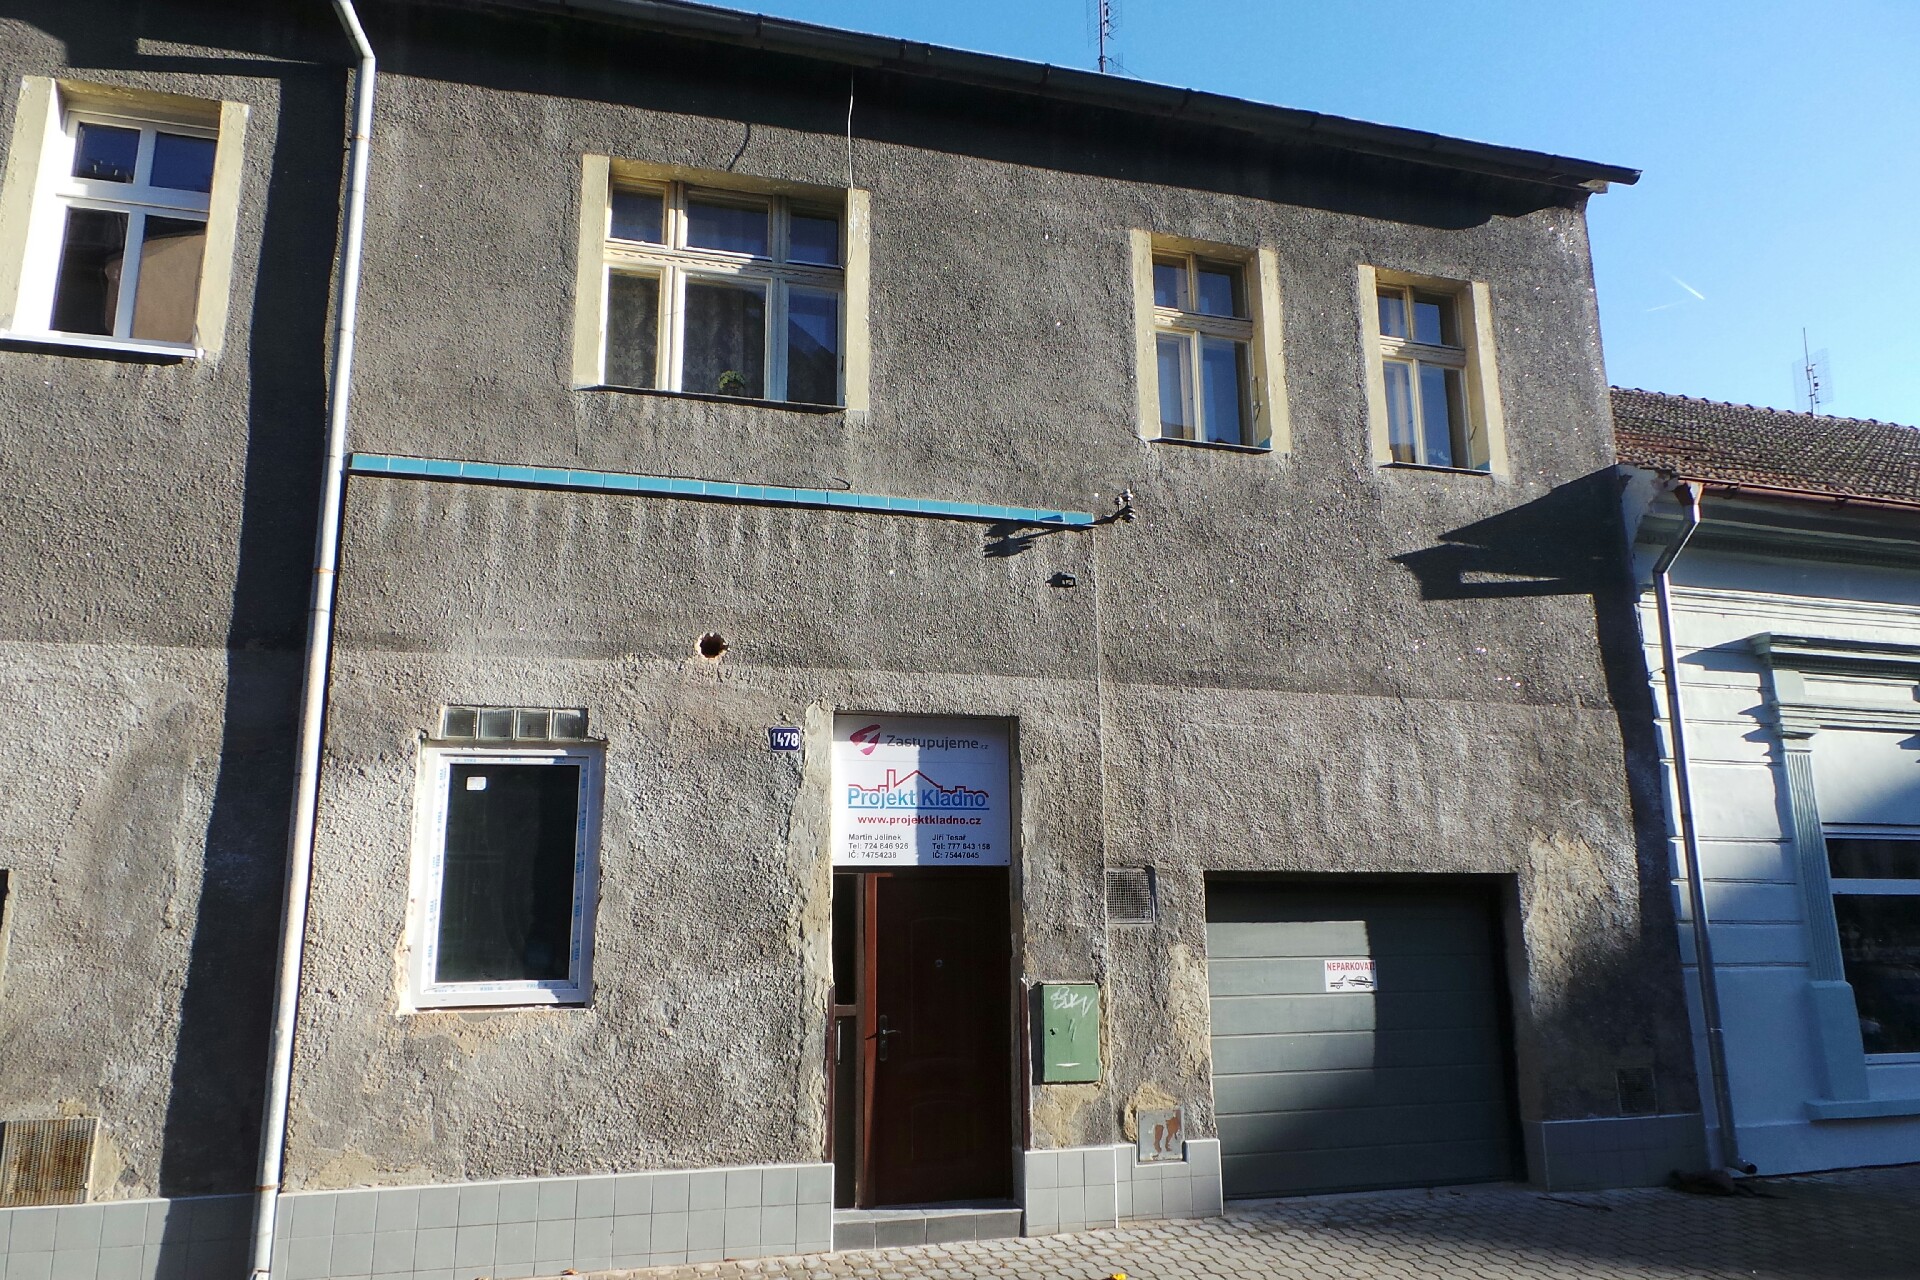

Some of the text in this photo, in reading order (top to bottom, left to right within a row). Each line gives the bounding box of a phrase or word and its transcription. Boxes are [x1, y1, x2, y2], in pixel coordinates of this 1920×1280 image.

[772, 732, 799, 747] 1478
[848, 787, 987, 809] Projekt Kladno
[857, 815, 982, 826] www.projektkladno.cz
[848, 833, 873, 841] Martin
[848, 842, 862, 850] Tel:
[864, 842, 878, 850] 724
[932, 842, 946, 850] Tel:
[947, 842, 961, 850] 777
[848, 850, 859, 859] IČ:
[932, 850, 980, 859] IČ: 75447045
